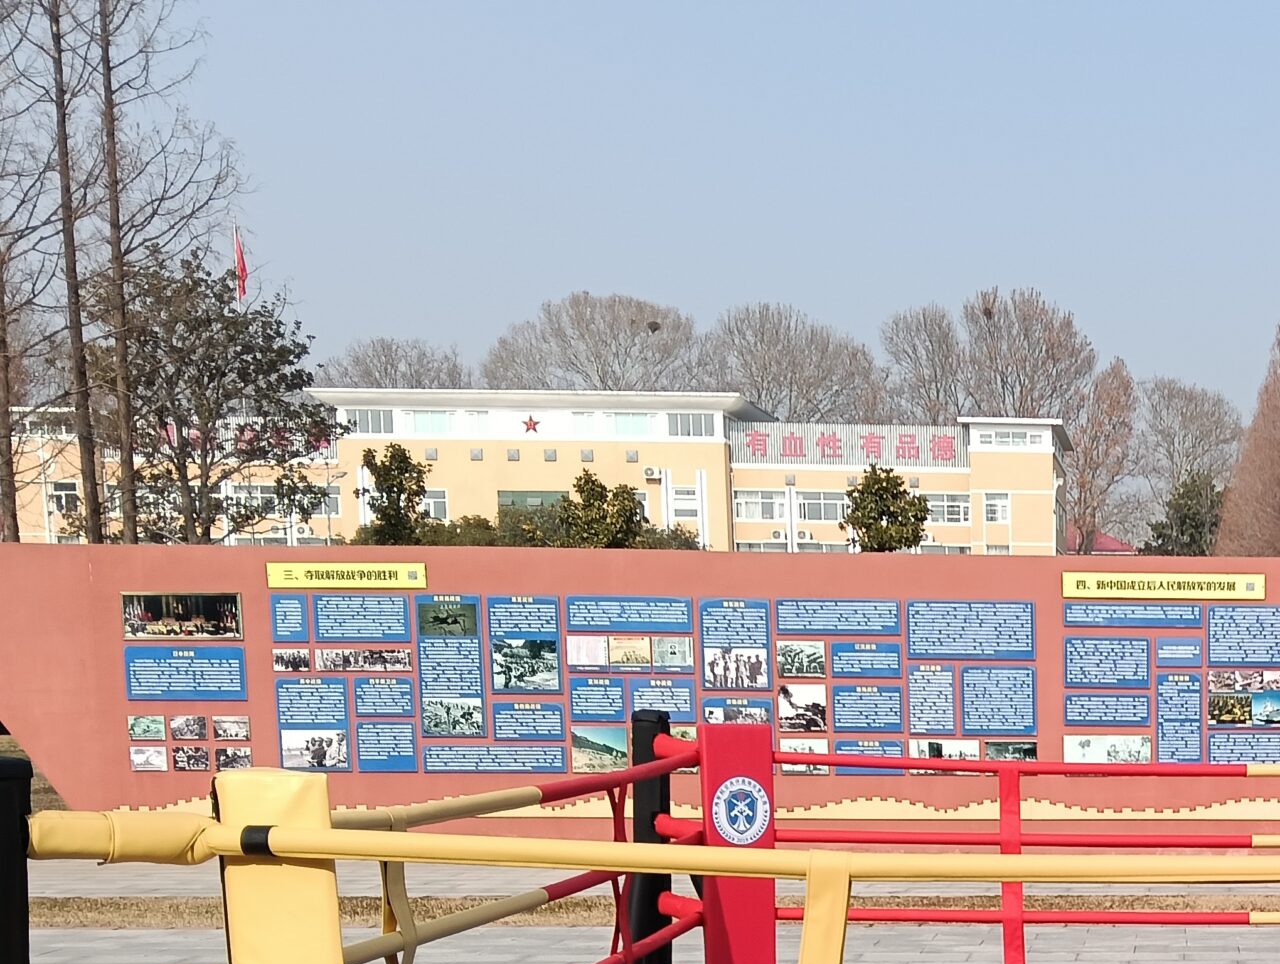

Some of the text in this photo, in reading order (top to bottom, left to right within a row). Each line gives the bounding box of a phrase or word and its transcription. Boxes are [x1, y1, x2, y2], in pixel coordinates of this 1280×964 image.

[745, 430, 956, 461] 有血性有品德
[283, 570, 398, 581] 三、夺取解放战争的胜利
[1076, 580, 1236, 591] 四、新中国成立后人民解放军的发展
